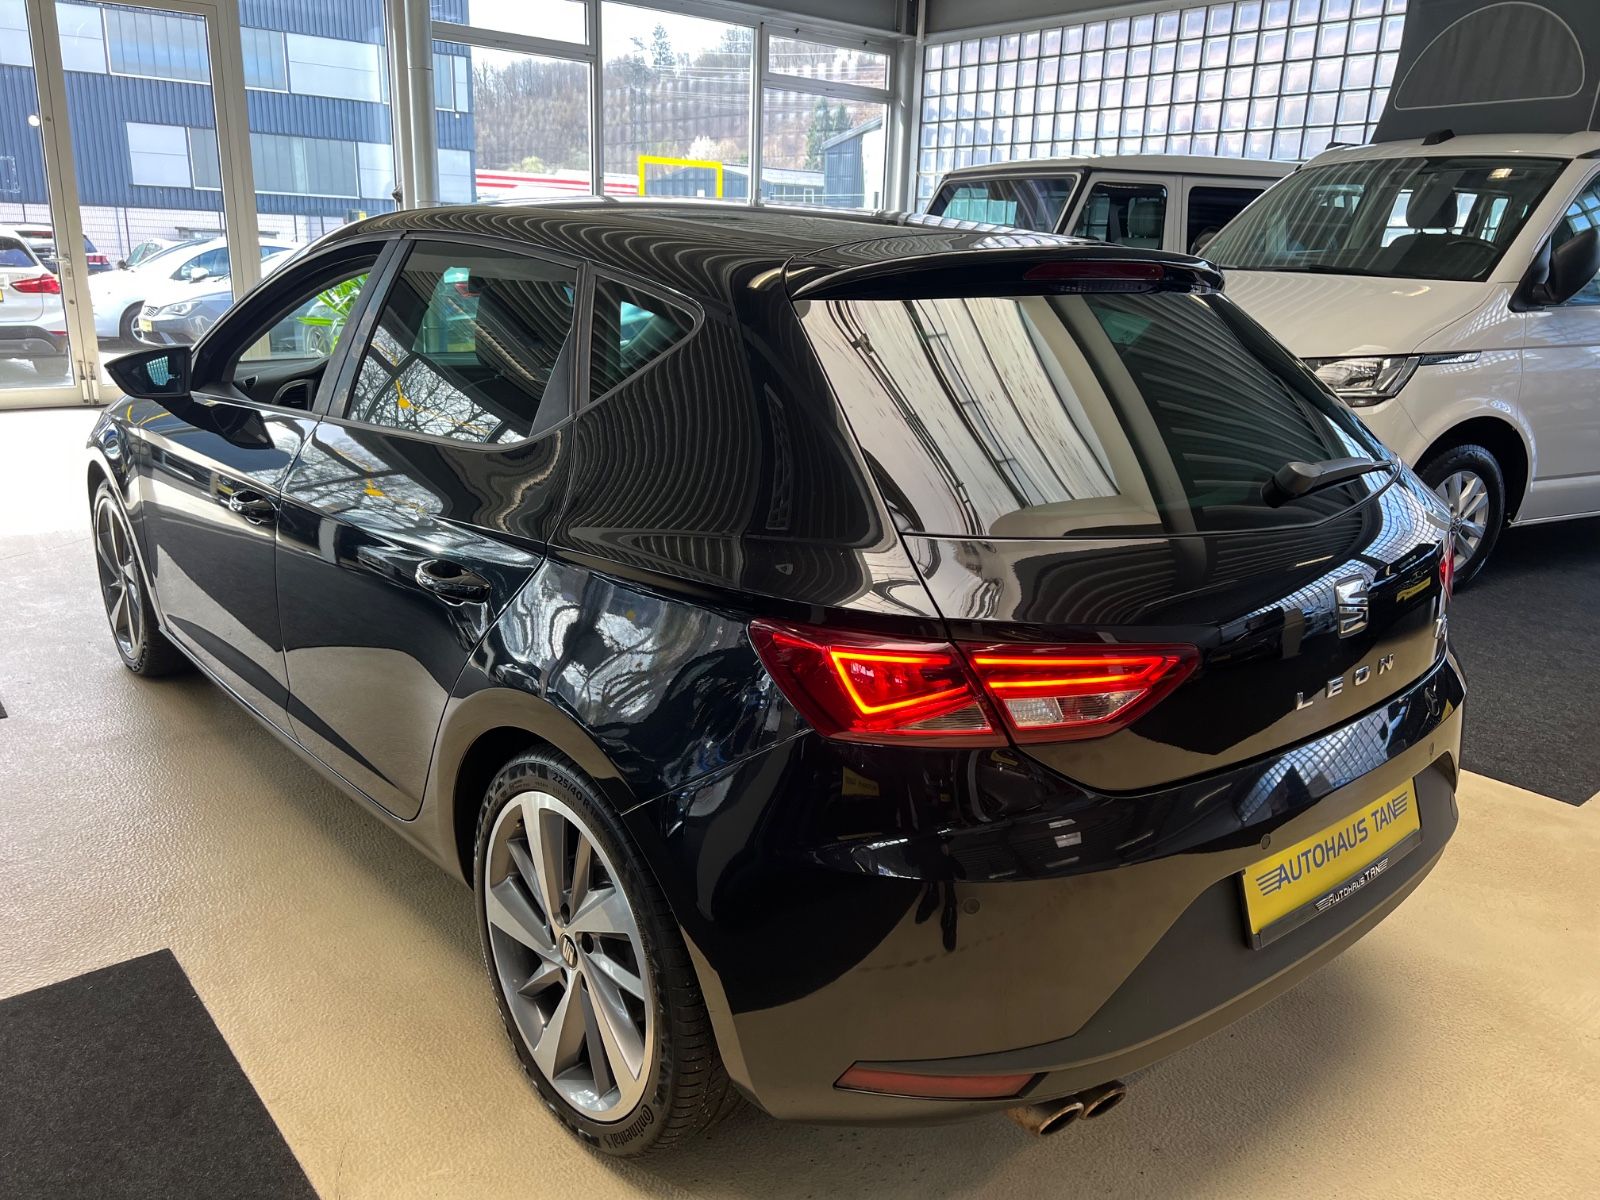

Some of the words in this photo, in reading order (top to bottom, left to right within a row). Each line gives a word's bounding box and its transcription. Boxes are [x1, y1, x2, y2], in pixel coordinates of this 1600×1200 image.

[1296, 653, 1394, 711] LEON
[552, 772, 583, 801] 225/40
[1276, 818, 1369, 890] AUTOHAUS
[1371, 798, 1398, 833] TAN
[1327, 876, 1365, 906] AUTOHAUS
[1364, 864, 1381, 882] TAN
